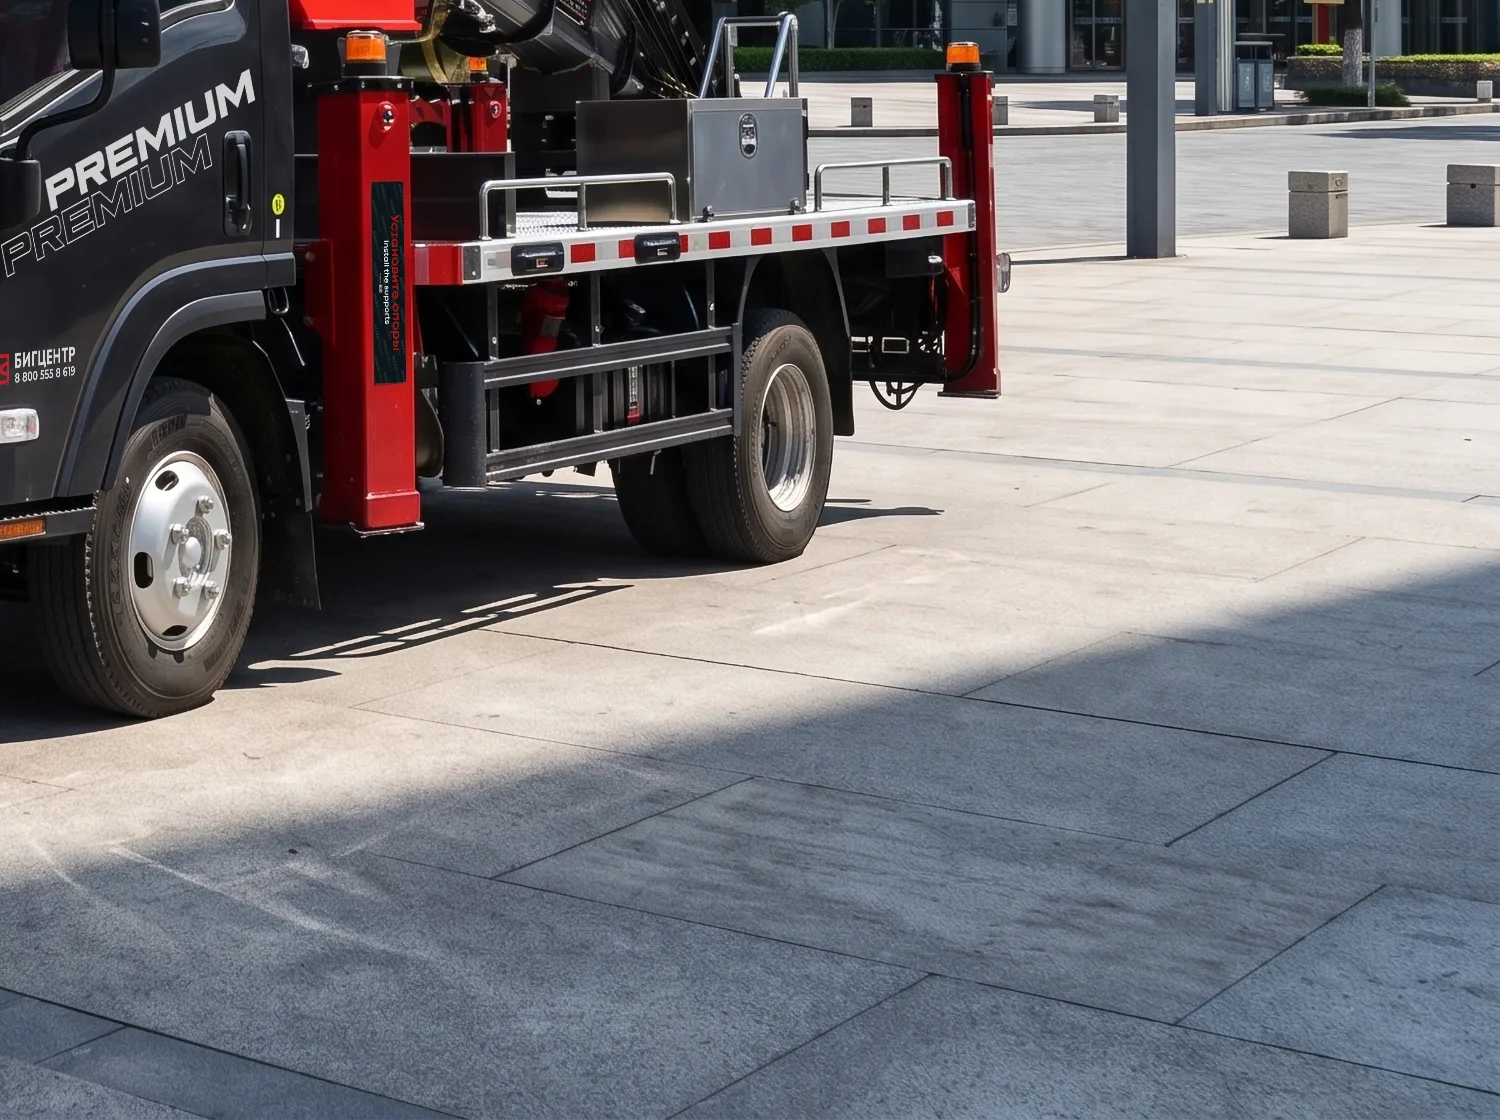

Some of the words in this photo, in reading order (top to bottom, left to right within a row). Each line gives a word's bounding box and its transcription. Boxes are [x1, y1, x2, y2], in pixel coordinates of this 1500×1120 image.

[45, 68, 256, 212] PREMIUM
[1, 132, 213, 278] PREMIUM
[390, 214, 400, 299] Установите
[14, 346, 75, 368] БИГЦЕНТР
[390, 302, 400, 351] опоры
[14, 372, 20, 383] 8
[22, 370, 38, 382] 800
[40, 368, 53, 380] 555
[55, 368, 60, 377] 8
[62, 366, 75, 376] 619
